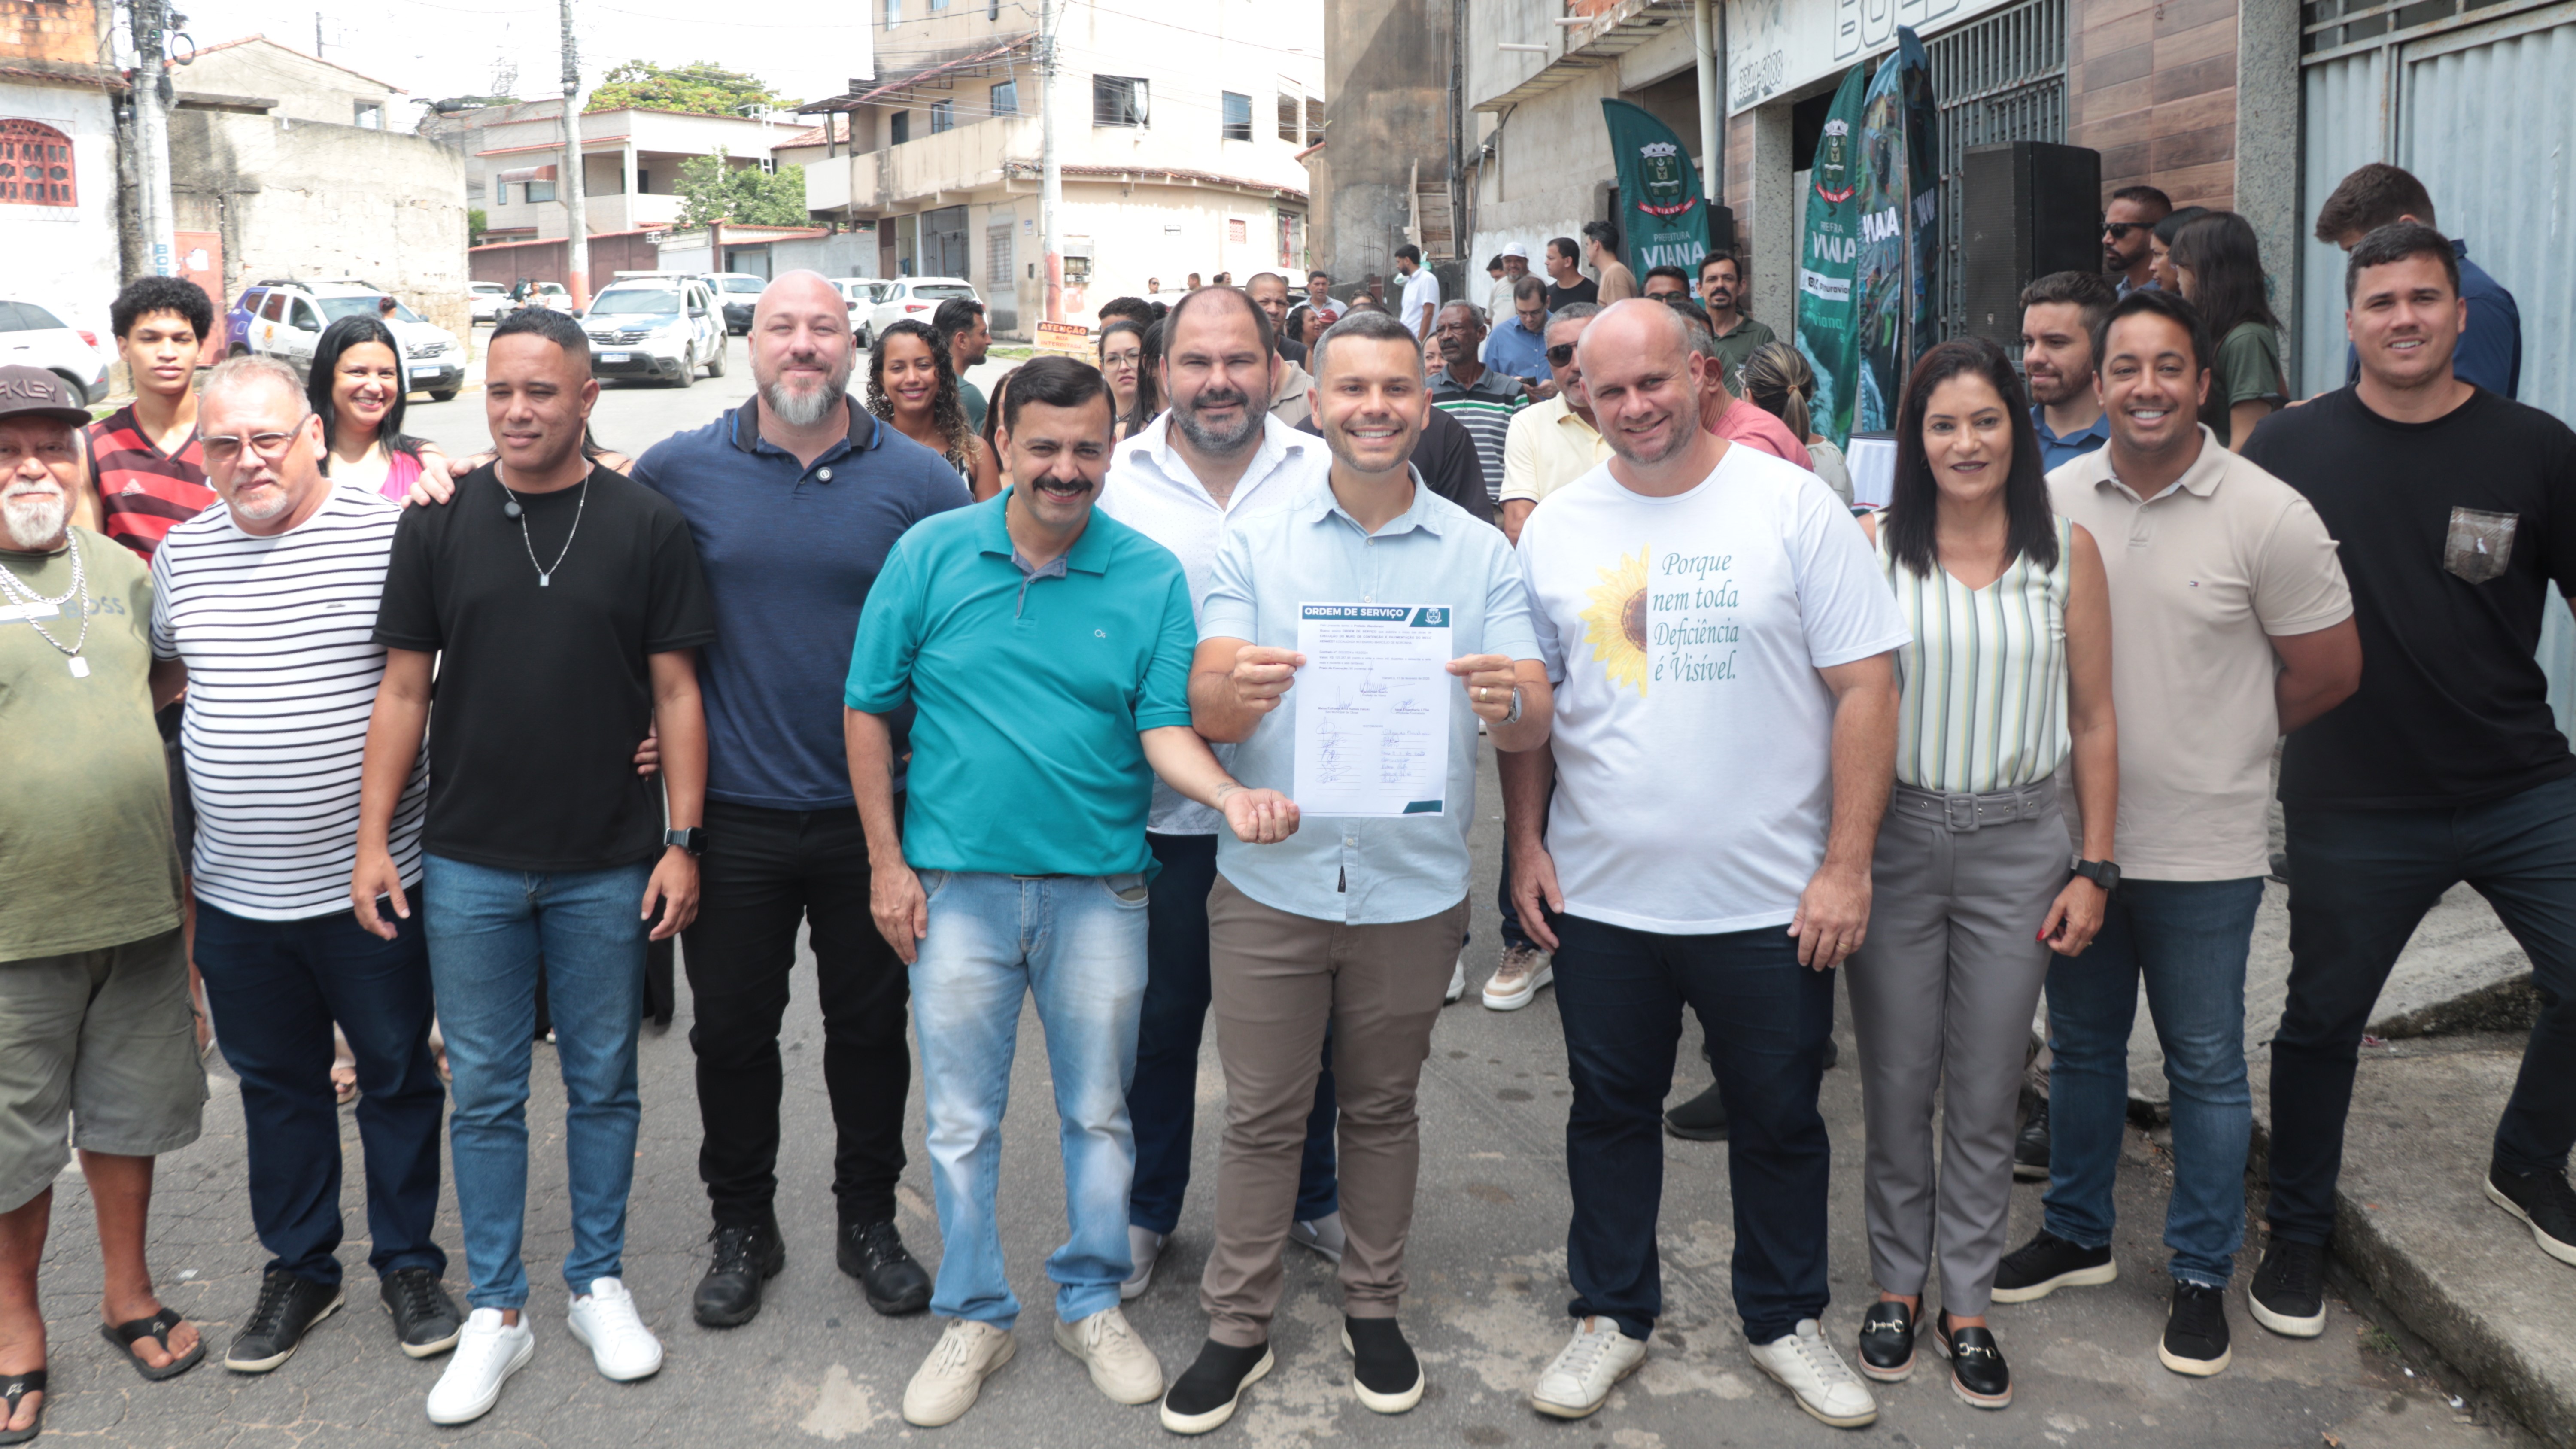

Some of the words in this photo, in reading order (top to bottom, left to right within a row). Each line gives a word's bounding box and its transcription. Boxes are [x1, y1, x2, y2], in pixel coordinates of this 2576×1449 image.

[1739, 49, 1783, 101] 3344-6088
[1657, 206, 1680, 214] VIANA
[1654, 231, 1690, 242] PREFEITURA
[1641, 241, 1706, 270] VIANA
[1040, 323, 1087, 335] ATENÇÃO
[1041, 340, 1081, 349] INTERDITADA
[1662, 553, 1732, 581] Porque
[63, 596, 125, 619] BOSS
[1653, 592, 1689, 611] nem
[1695, 579, 1739, 609] toda
[1361, 608, 1404, 618] SERVIÇO
[1654, 617, 1739, 655] Deficiência
[1655, 656, 1664, 681] é
[1670, 650, 1737, 682] Visível.
